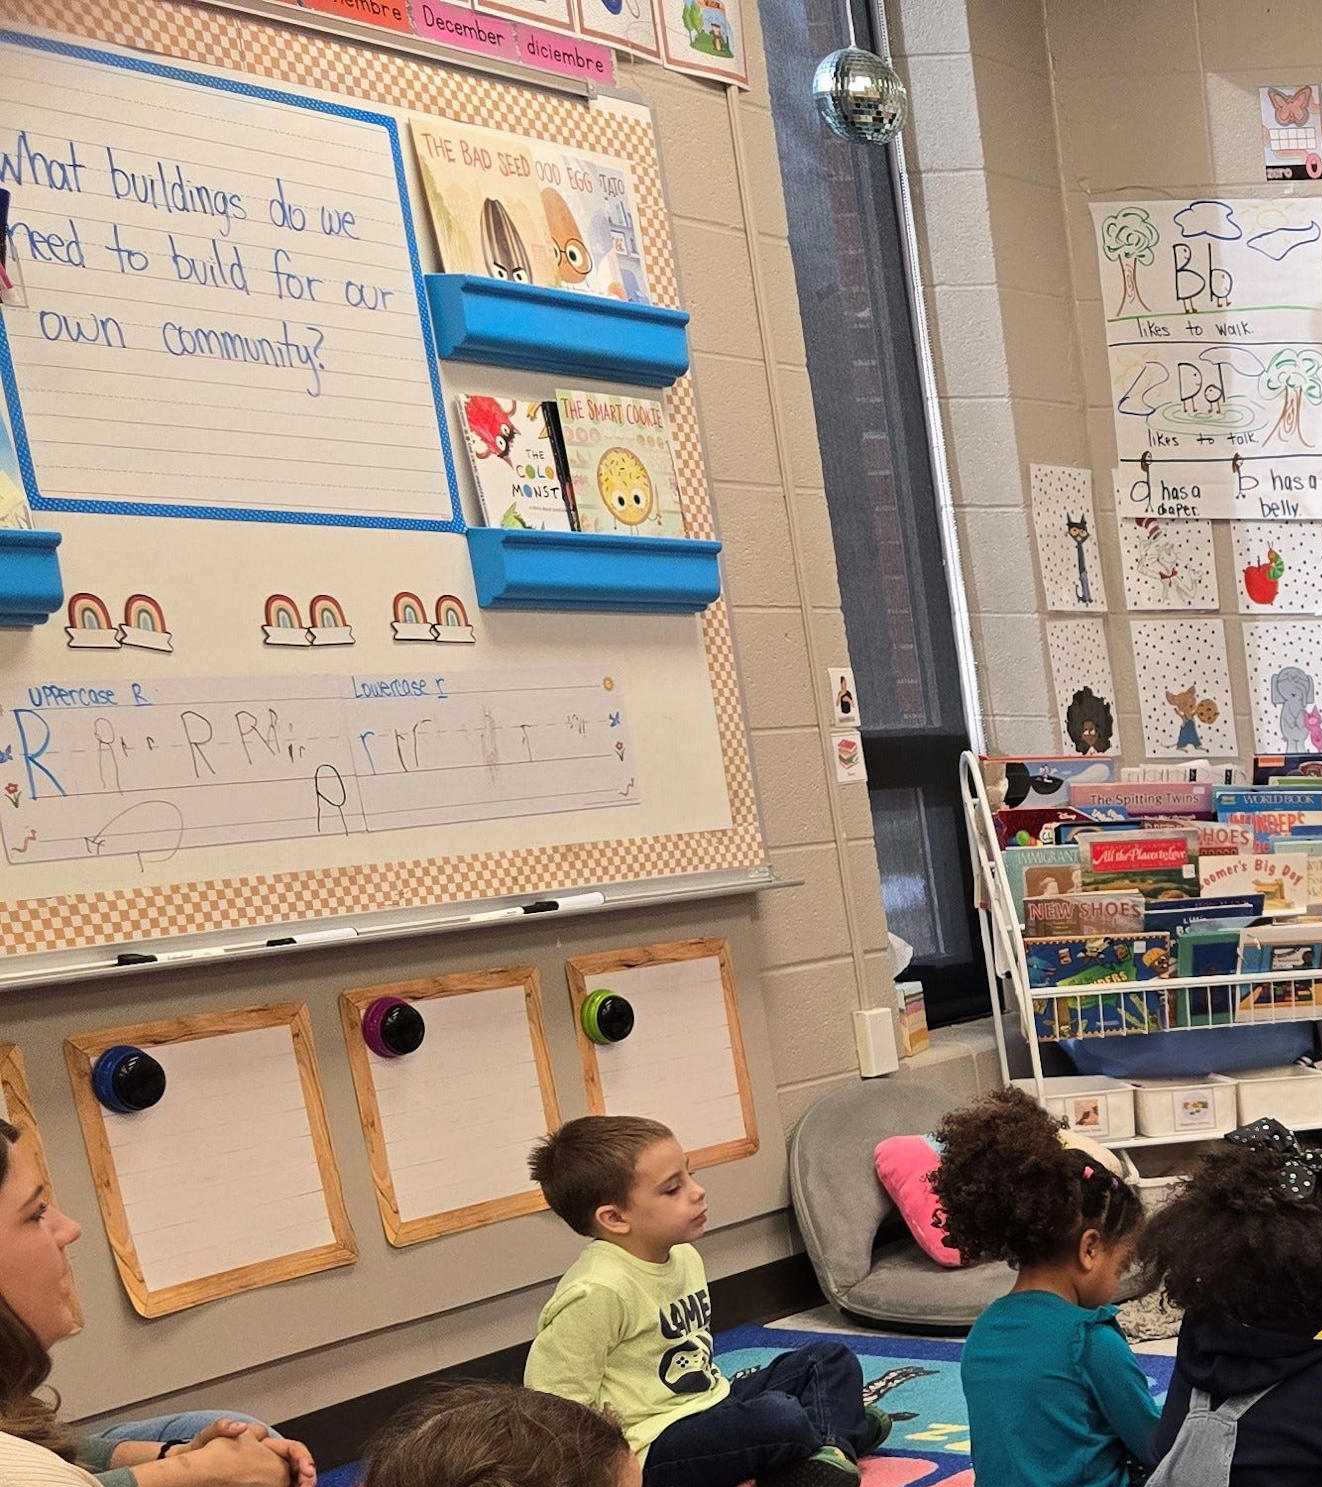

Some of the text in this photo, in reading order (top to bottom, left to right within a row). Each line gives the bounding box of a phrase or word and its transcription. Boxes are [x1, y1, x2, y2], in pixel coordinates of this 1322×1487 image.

[423, 5, 505, 47] December
[528, 40, 604, 73] diciembre
[421, 133, 531, 178] THE BAD SEED
[1305, 153, 1322, 178] 0
[107, 147, 247, 237] buildings
[269, 177, 306, 231] do
[321, 205, 358, 240] we
[567, 167, 593, 193] EGG
[6, 220, 395, 310] need to build for our
[1173, 242, 1233, 301] Bb
[1138, 319, 1170, 339] likes
[1185, 320, 1203, 337] to
[39, 309, 325, 397] own community?
[1177, 363, 1225, 402] Dd
[560, 398, 663, 429] THE SMART COOKIE
[1148, 429, 1180, 447] likes
[1197, 434, 1216, 446] to
[131, 682, 153, 707] R
[1090, 793, 1199, 806] The Spitting Twins
[1254, 859, 1304, 885] Big Day
[1028, 902, 1142, 921] NEW SHOES
